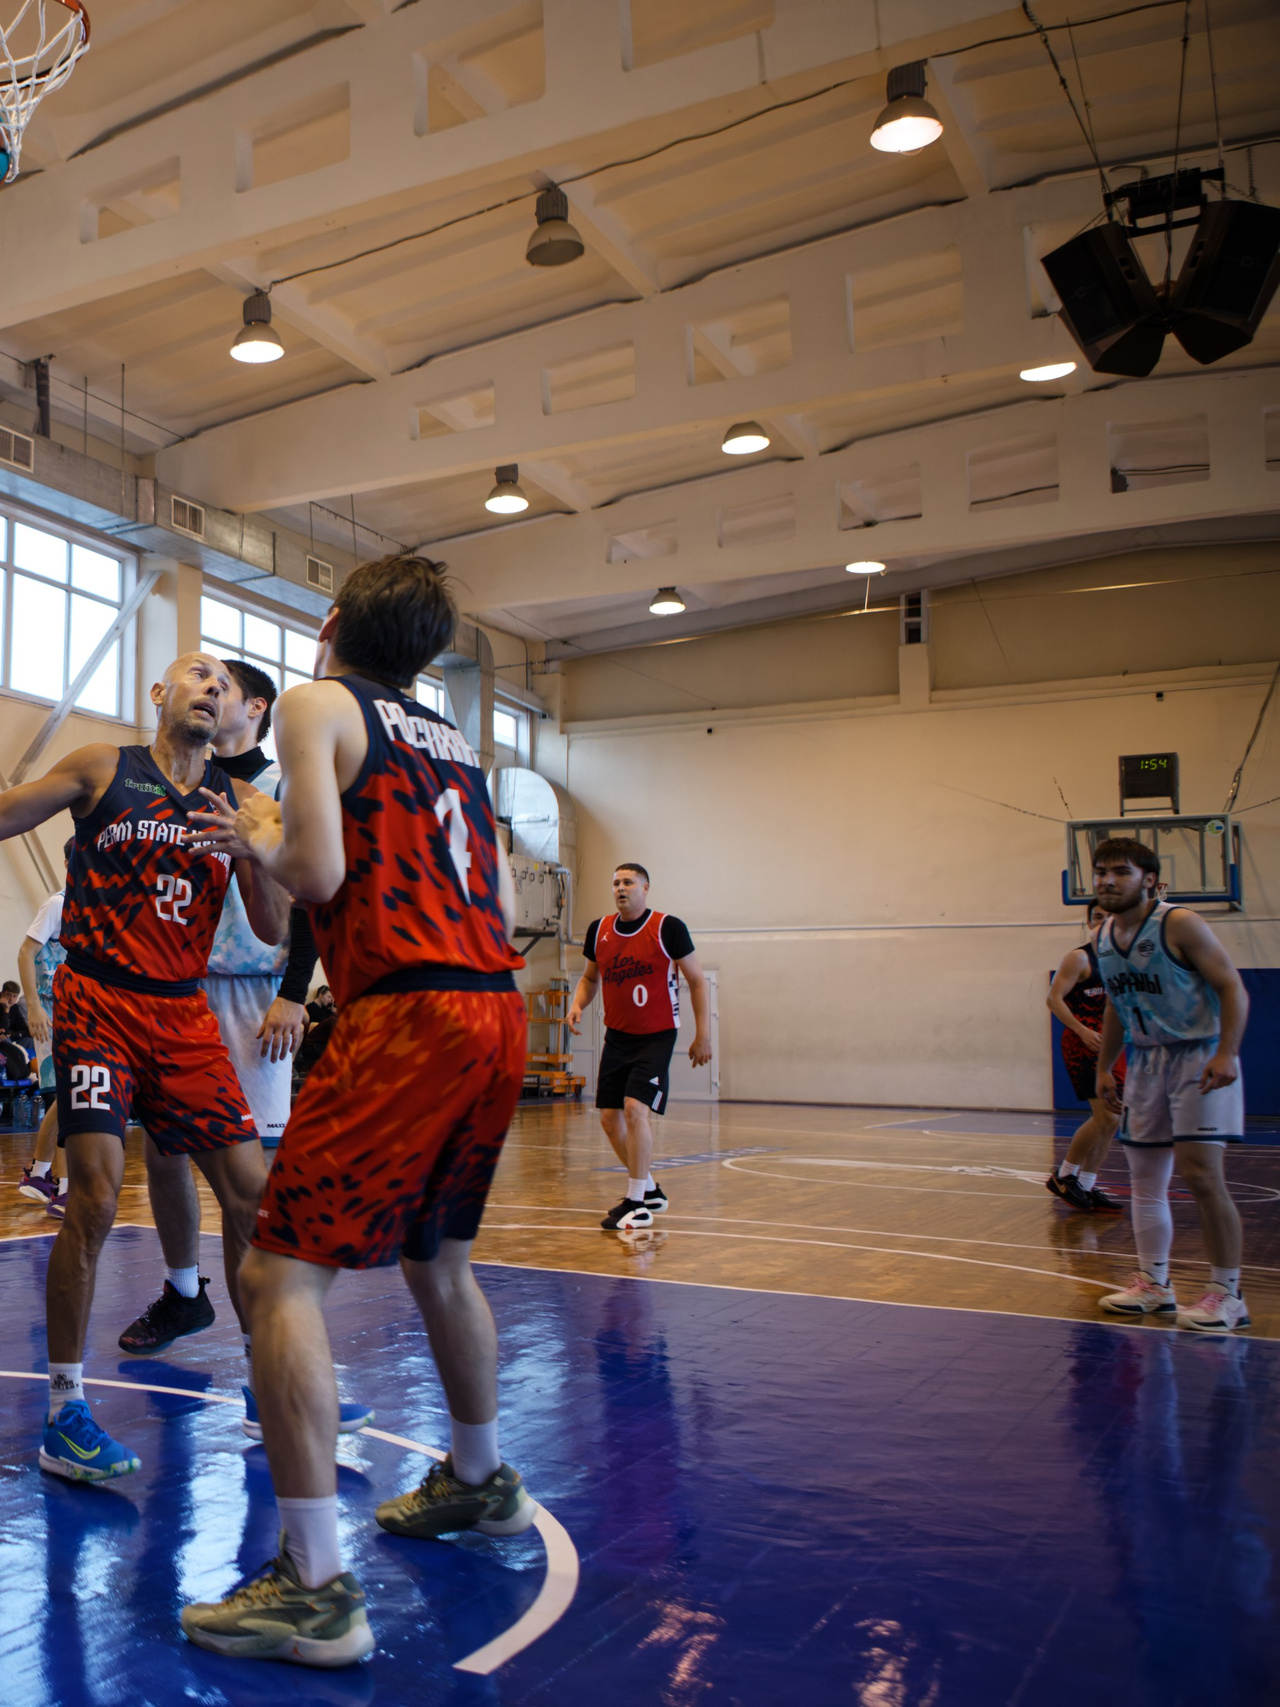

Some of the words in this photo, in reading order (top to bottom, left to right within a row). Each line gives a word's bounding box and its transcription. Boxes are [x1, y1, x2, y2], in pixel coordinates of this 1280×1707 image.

[1139, 758, 1167, 771] 1:54
[125, 778, 166, 797] fruitit
[97, 820, 133, 852] PERM
[137, 819, 188, 847] STATE
[155, 873, 192, 926] 22
[603, 960, 654, 988] Angeles
[612, 952, 635, 969] Los
[632, 984, 648, 1007] 0
[1132, 1006, 1148, 1036] 1
[71, 1064, 111, 1111] 22
